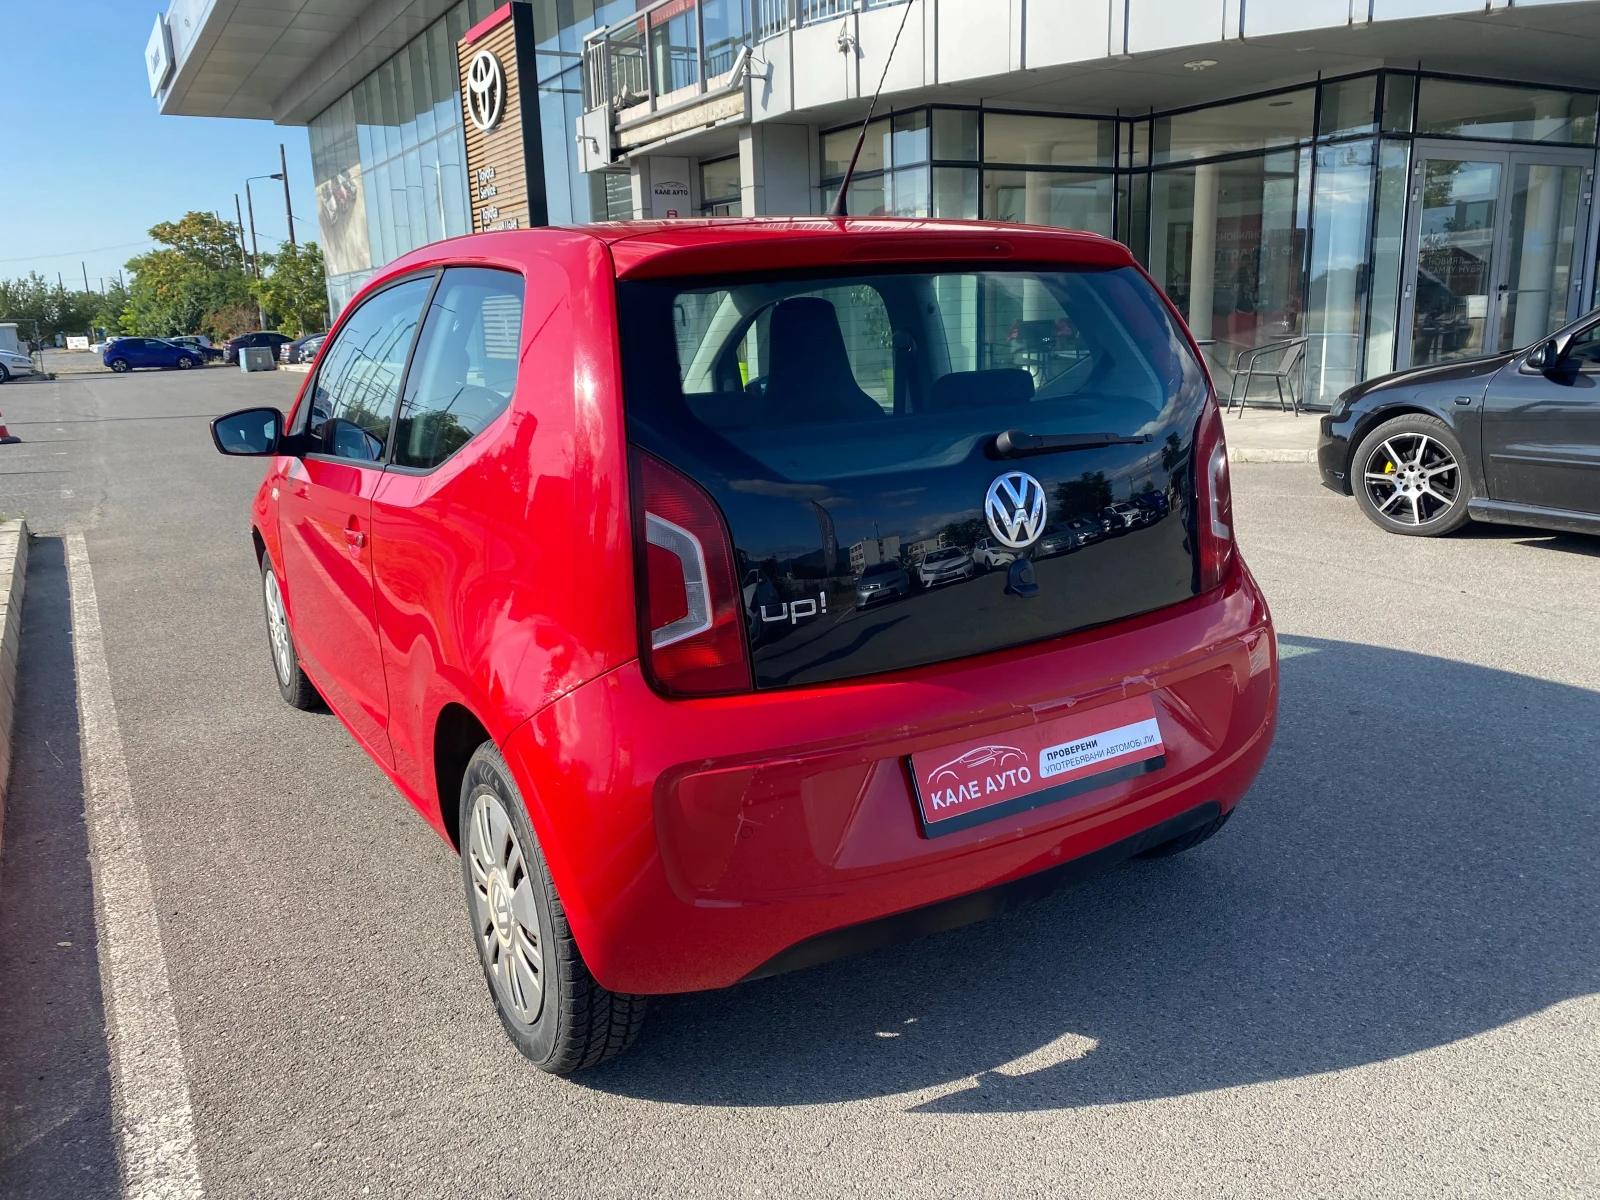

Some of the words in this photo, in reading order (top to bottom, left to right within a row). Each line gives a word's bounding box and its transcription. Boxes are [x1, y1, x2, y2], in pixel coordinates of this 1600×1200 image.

[760, 591, 827, 625] up!
[1044, 749, 1105, 775] УПОТРЕБЯВАНИ
[1046, 739, 1098, 761] ПРОВЕРЕНИ
[931, 780, 982, 810] КАЛЕ
[985, 766, 1031, 791] АУТО
